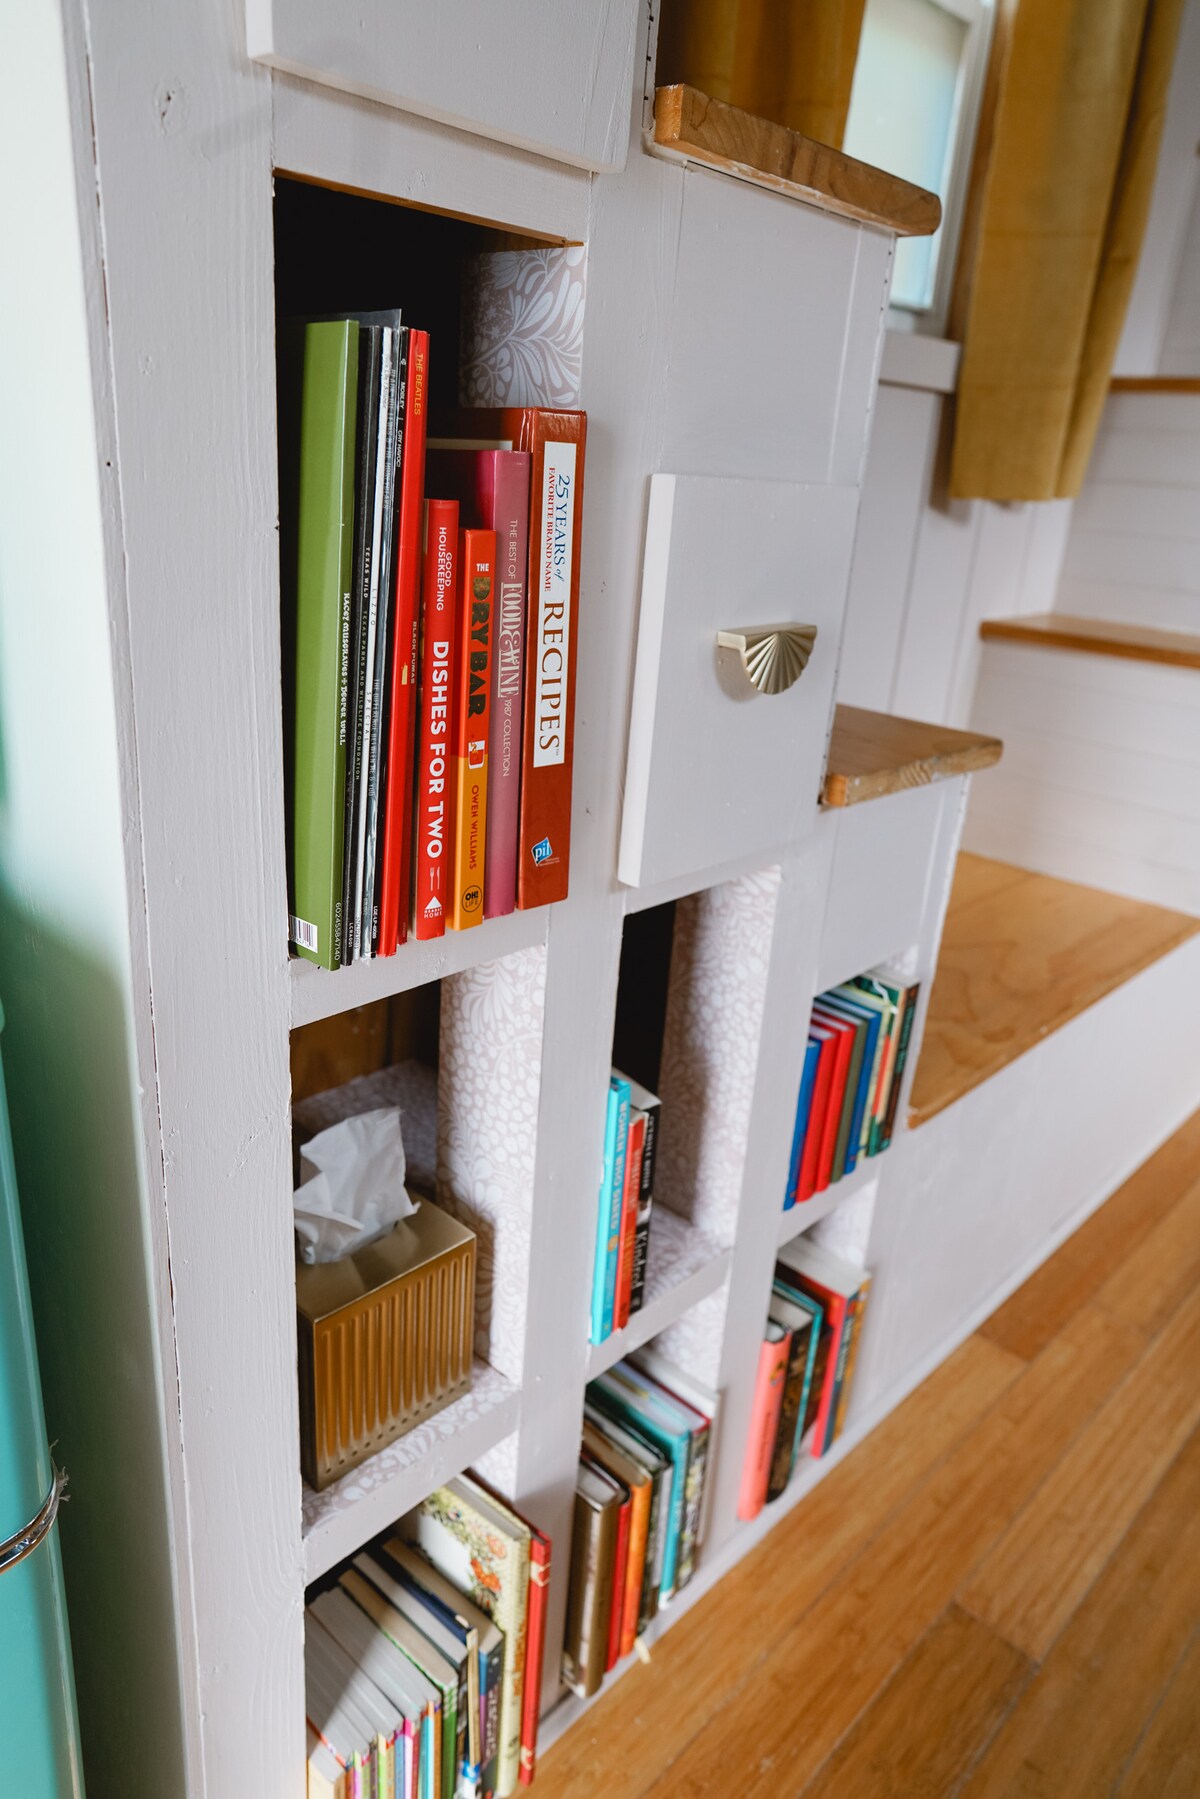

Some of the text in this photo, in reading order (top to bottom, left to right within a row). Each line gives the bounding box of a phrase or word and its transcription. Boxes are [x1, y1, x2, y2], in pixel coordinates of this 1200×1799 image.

[414, 353, 424, 415] THE BEATLES
[508, 520, 518, 580] THE BEST OF
[544, 467, 556, 592] FAVORITE BRAND NAME
[554, 474, 570, 582] 25 YEARS of
[436, 526, 446, 611] HOUSEKEEPING
[476, 563, 489, 572] THE
[468, 576, 490, 719] DRY BAR
[539, 600, 565, 750] RECIPES
[364, 692, 372, 741] SPECIAL
[426, 641, 449, 858] DISHES FOR TWO
[502, 699, 512, 776] 1987 COLLECTION
[469, 784, 480, 870] OWEN WILLIAMS
[536, 843, 550, 863] pil
[616, 1100, 628, 1152] WOMEN
[613, 1154, 624, 1186] WHO
[631, 1230, 648, 1290] Kindred
